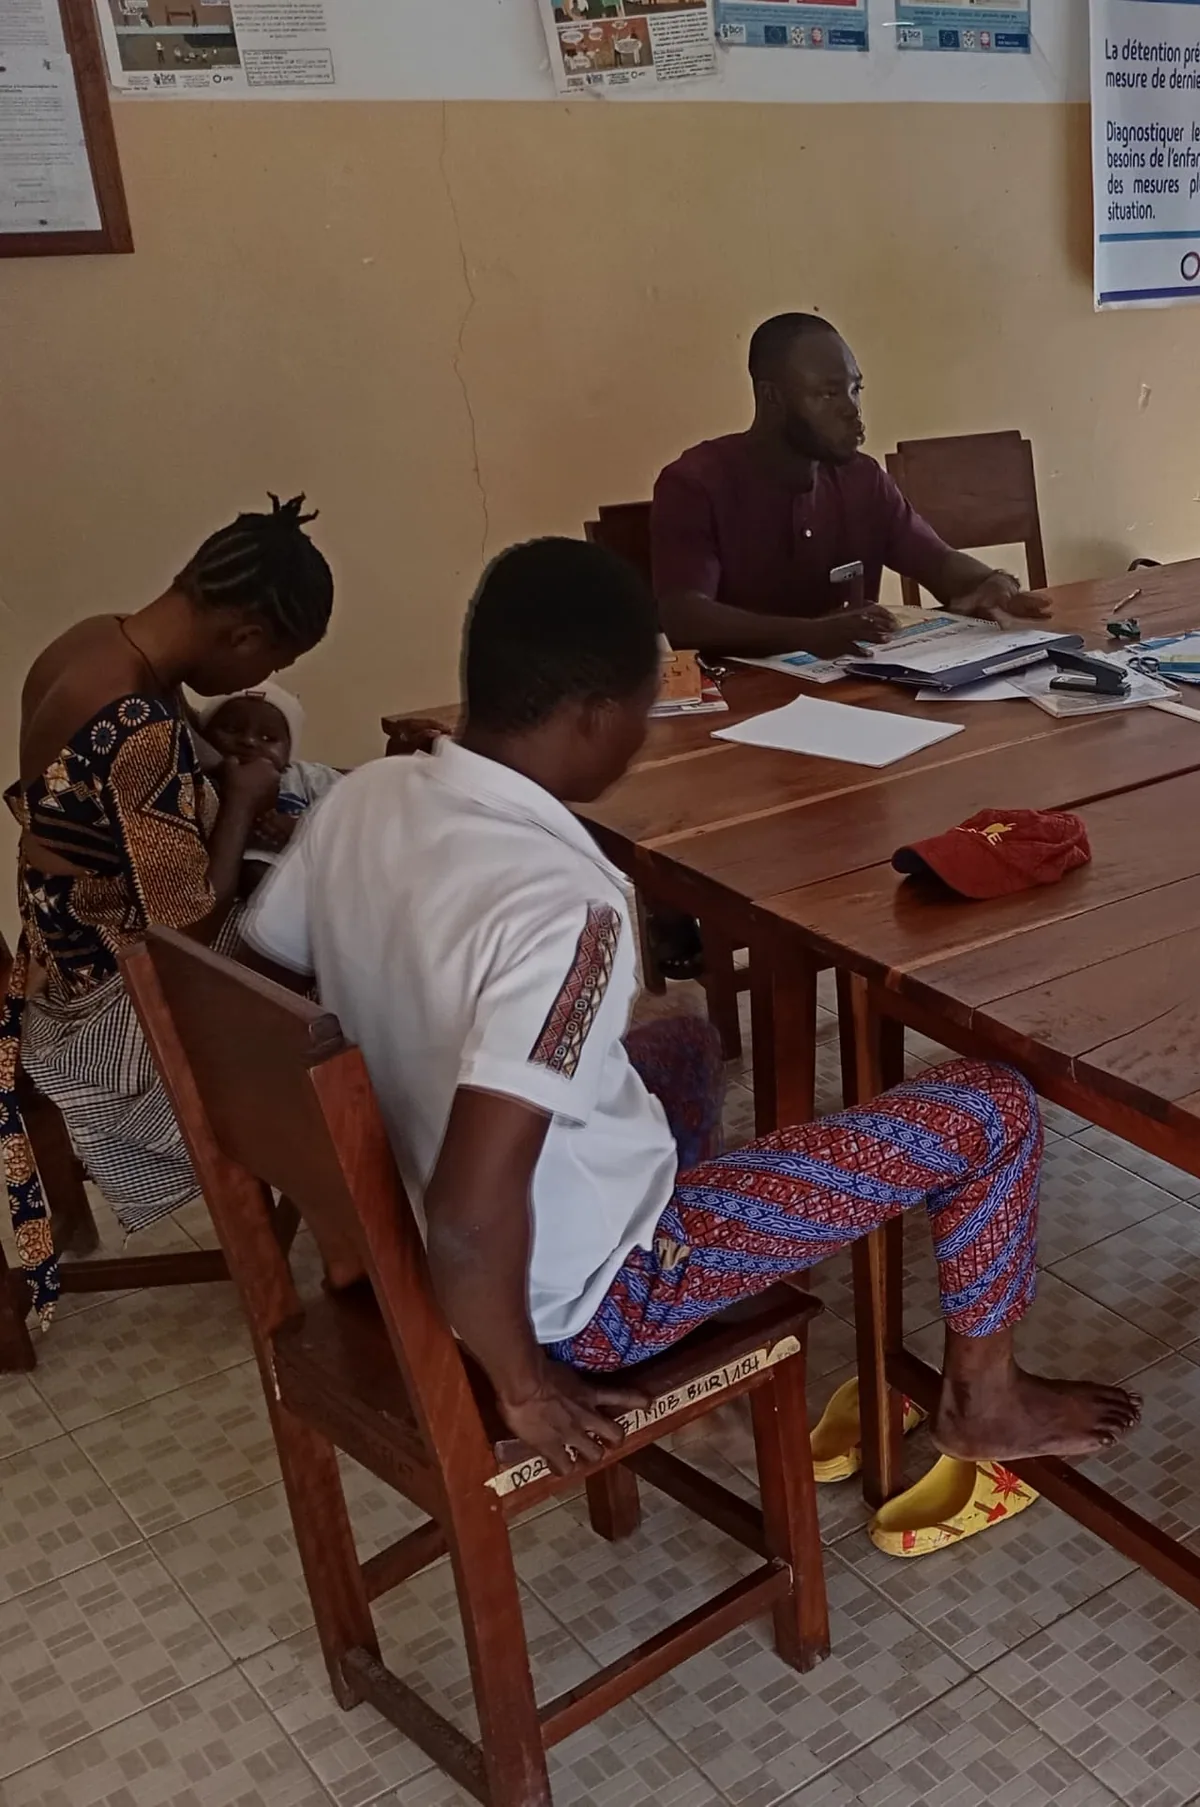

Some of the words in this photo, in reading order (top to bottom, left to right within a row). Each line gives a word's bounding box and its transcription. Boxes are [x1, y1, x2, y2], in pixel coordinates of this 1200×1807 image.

[1105, 38, 1117, 60] La
[1122, 39, 1181, 63] détention
[1106, 70, 1147, 88] mesure
[1152, 67, 1166, 89] de
[1106, 121, 1184, 147] Diagnostiquer
[1107, 148, 1146, 168] besoins
[1150, 147, 1164, 167] de
[1107, 173, 1124, 195] des
[1133, 178, 1180, 194] mesures
[1107, 201, 1156, 221] situation.
